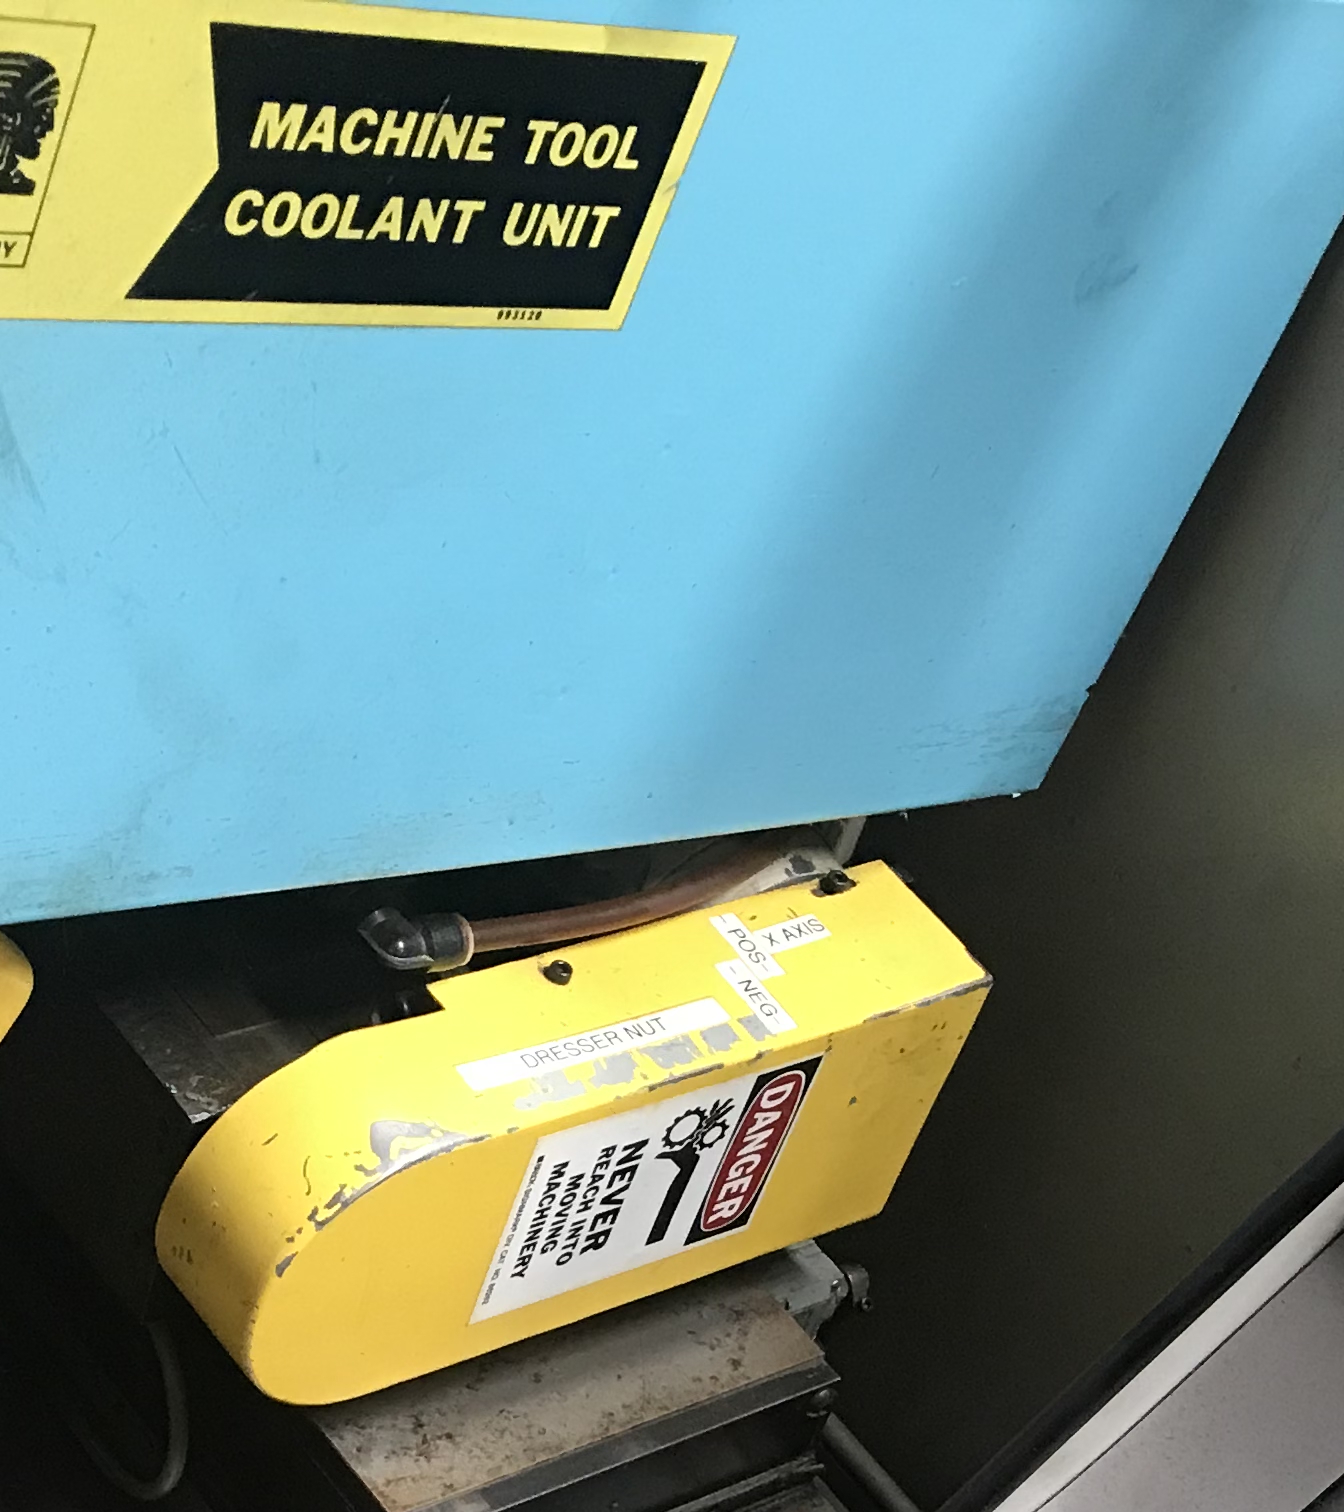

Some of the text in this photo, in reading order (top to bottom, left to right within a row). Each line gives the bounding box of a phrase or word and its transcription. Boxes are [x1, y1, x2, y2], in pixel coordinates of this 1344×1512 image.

[250, 100, 639, 169] MACHINE TOOL
[223, 189, 621, 249] COOLANT UNIT
[727, 928, 766, 965] POS
[761, 918, 826, 947] X AXIS
[737, 979, 778, 1018] NEG
[520, 1017, 666, 1068] DRESSER NUT
[707, 1080, 798, 1225] DANGER
[510, 1160, 571, 1279] MACHINERY
[540, 1173, 585, 1255] MOVING
[556, 1144, 617, 1267] REACH INTO
[579, 1138, 650, 1255] NEVER
